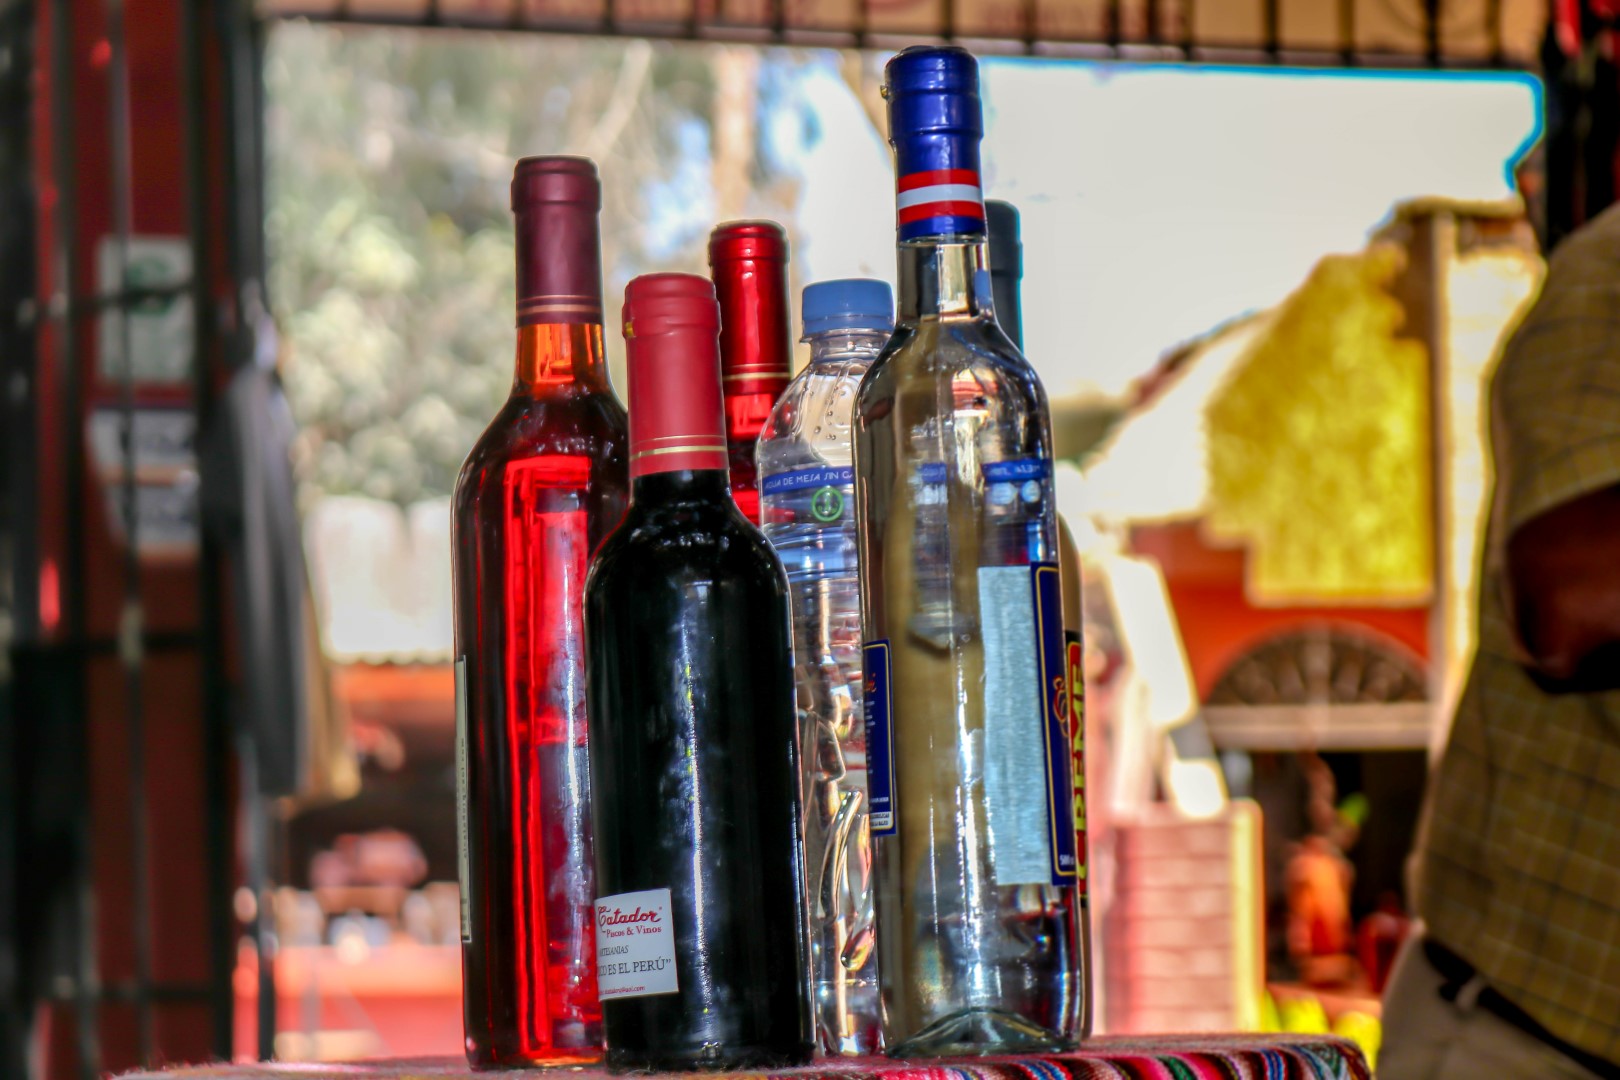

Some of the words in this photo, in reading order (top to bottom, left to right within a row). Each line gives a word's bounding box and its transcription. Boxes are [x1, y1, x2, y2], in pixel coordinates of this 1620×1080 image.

[783, 477, 793, 486] DE
[796, 474, 820, 483] MESA
[824, 472, 839, 480] SIN
[626, 927, 634, 936] &
[636, 926, 662, 934] Vinos
[608, 964, 617, 976] ES
[618, 963, 631, 974] EL
